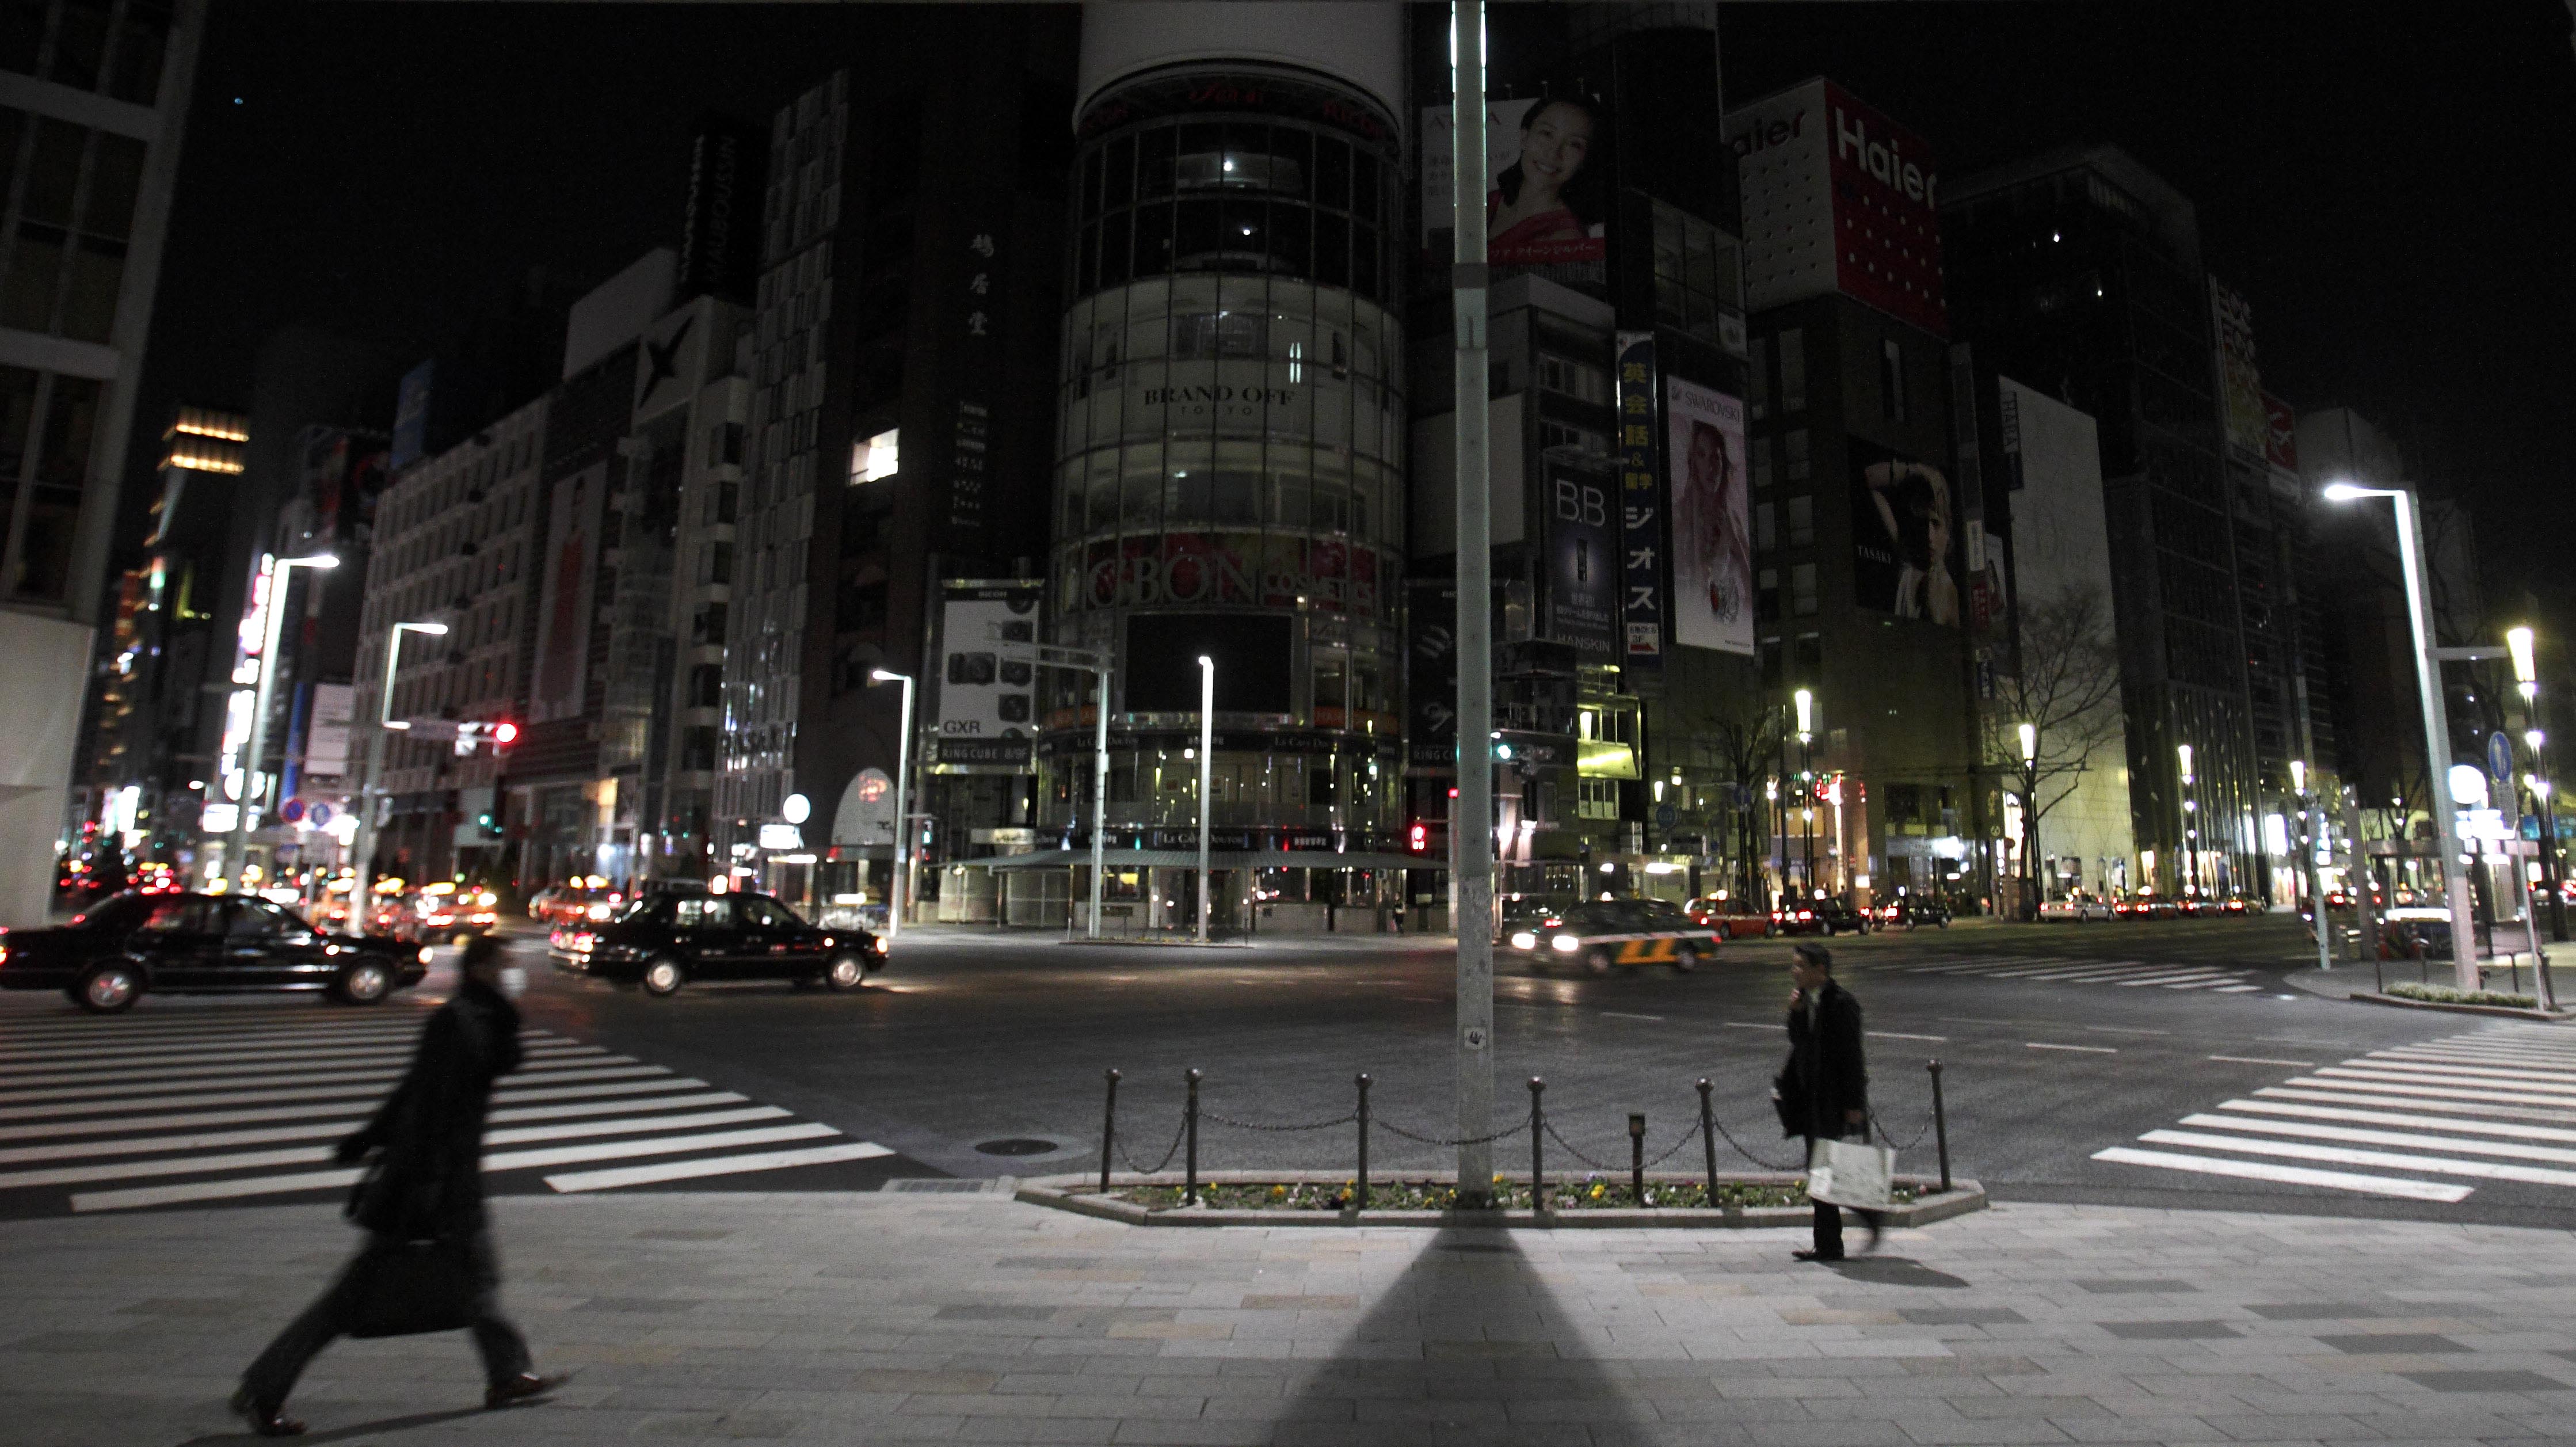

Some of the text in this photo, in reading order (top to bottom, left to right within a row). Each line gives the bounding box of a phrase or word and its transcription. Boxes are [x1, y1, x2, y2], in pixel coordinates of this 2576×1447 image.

[1732, 109, 1805, 157] aier
[1835, 107, 1937, 210] Haier
[1145, 386, 1295, 406] BRAND OFF
[1685, 391, 1741, 421] SWAROVSKI
[1182, 405, 1252, 416] TOYO
[1625, 505, 1657, 611] ジオス
[944, 720, 981, 734] GXR
[942, 747, 968, 759] RING
